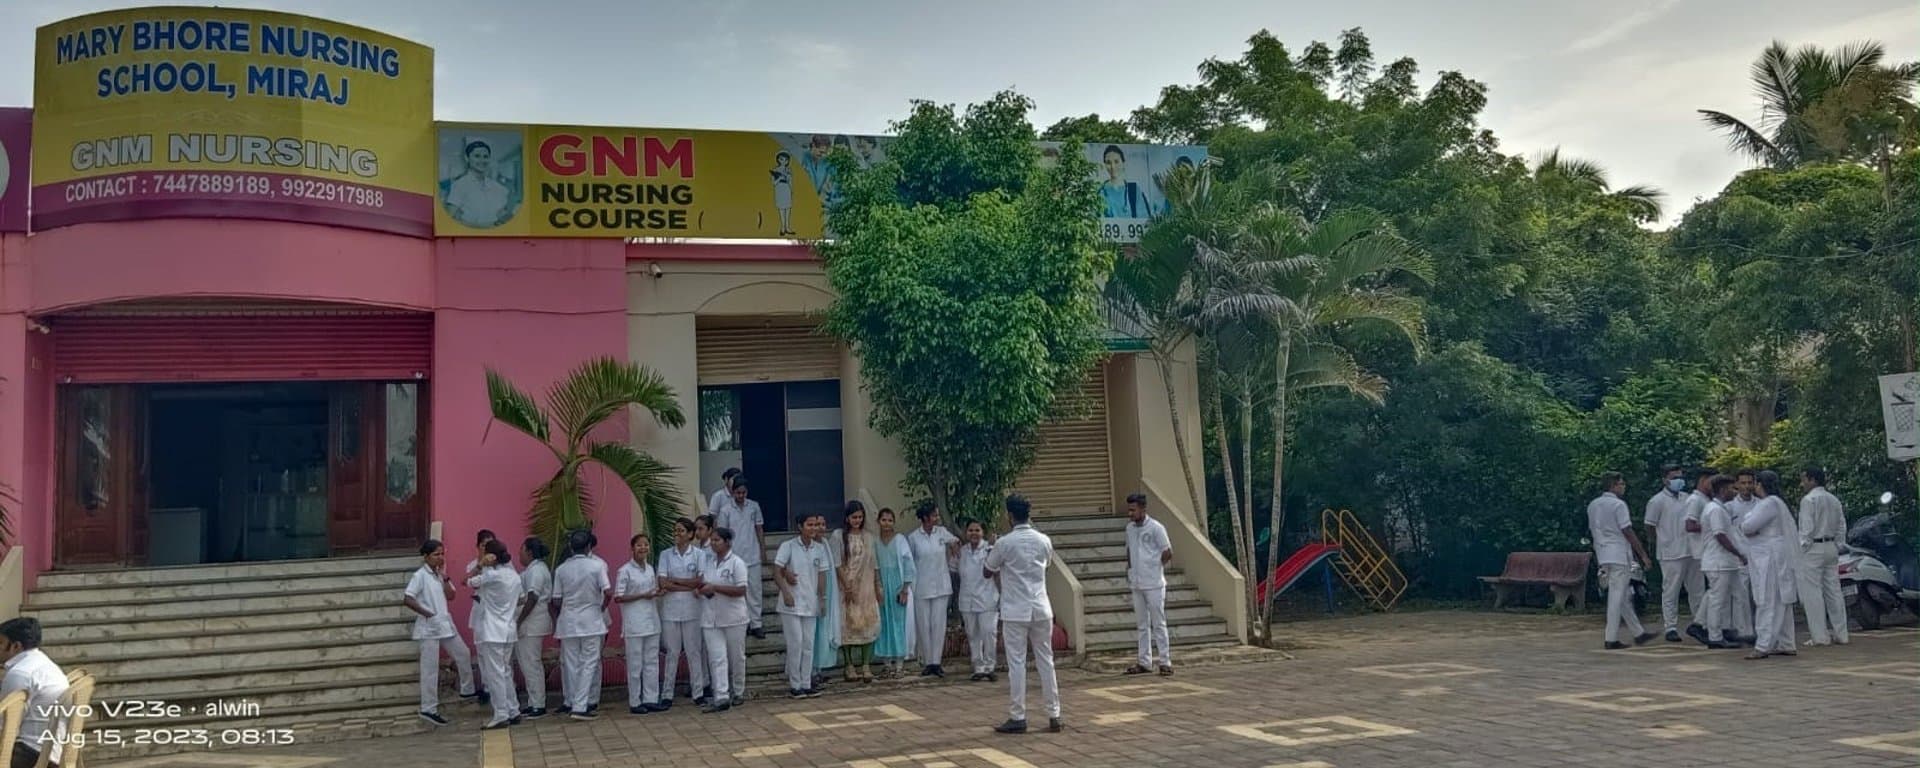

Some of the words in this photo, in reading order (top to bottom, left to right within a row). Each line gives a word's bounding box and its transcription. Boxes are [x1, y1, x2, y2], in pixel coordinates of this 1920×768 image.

[56, 25, 125, 65] MARY
[132, 21, 250, 53] BHORE
[261, 25, 400, 78] NURSING
[97, 62, 235, 99] SCHOOL,
[248, 66, 349, 105] MIRAJ
[71, 134, 152, 171] GNM
[168, 133, 378, 177] NURSING
[538, 133, 694, 179] GNM
[66, 175, 137, 203] CONTACT
[153, 174, 275, 197] 7447889189,
[281, 178, 384, 208] 9922917988
[541, 183, 693, 206] NURSING
[548, 208, 688, 230] COURSE
